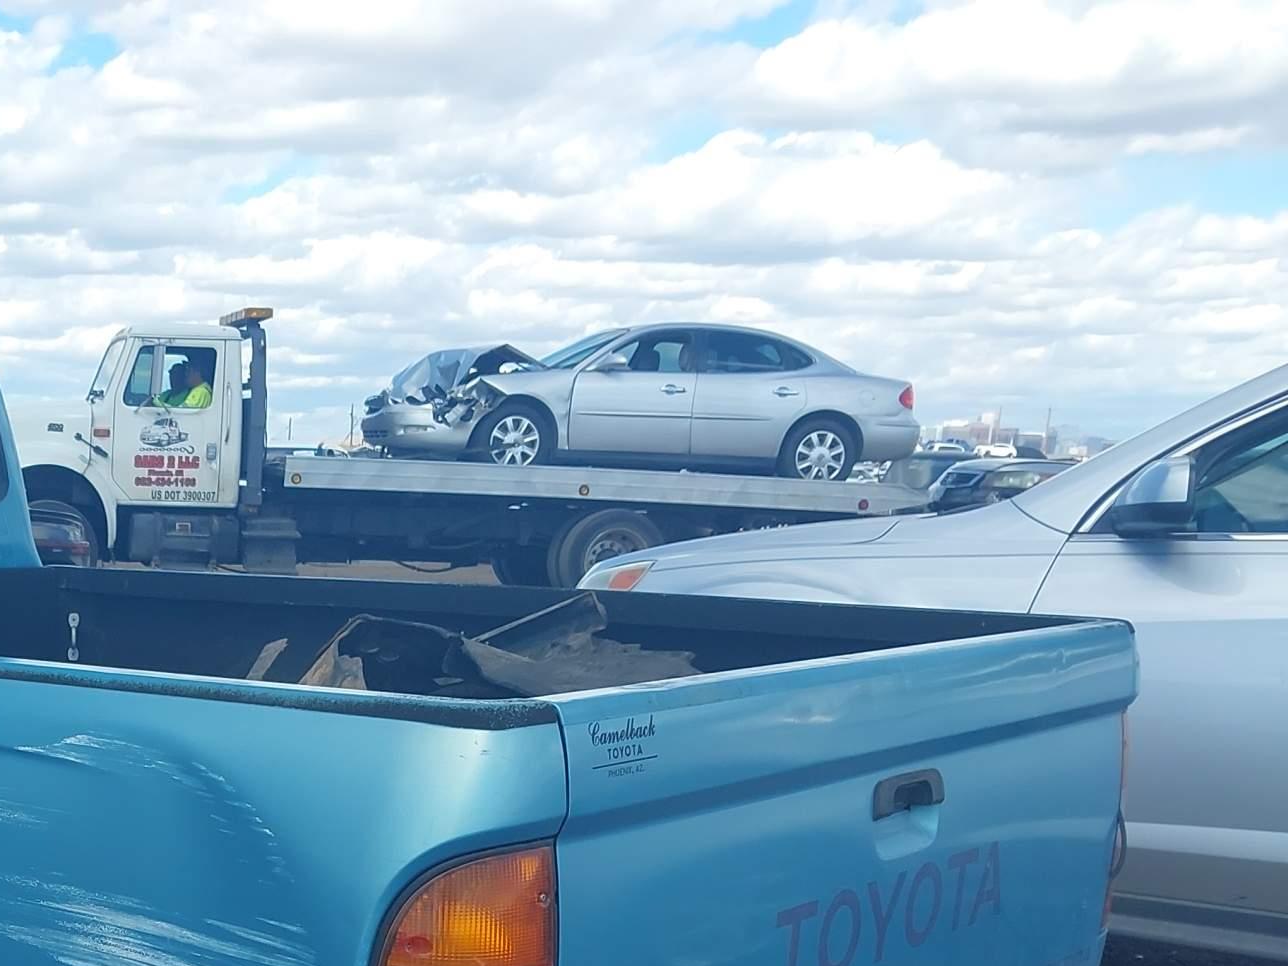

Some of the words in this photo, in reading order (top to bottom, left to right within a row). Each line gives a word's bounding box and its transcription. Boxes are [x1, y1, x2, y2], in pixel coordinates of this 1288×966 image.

[178, 456, 200, 468] LLC
[151, 490, 163, 500] US
[164, 490, 181, 501] DOT
[183, 491, 216, 502] 3900307
[588, 713, 656, 747] Camelback
[607, 744, 643, 760] TOYOTA
